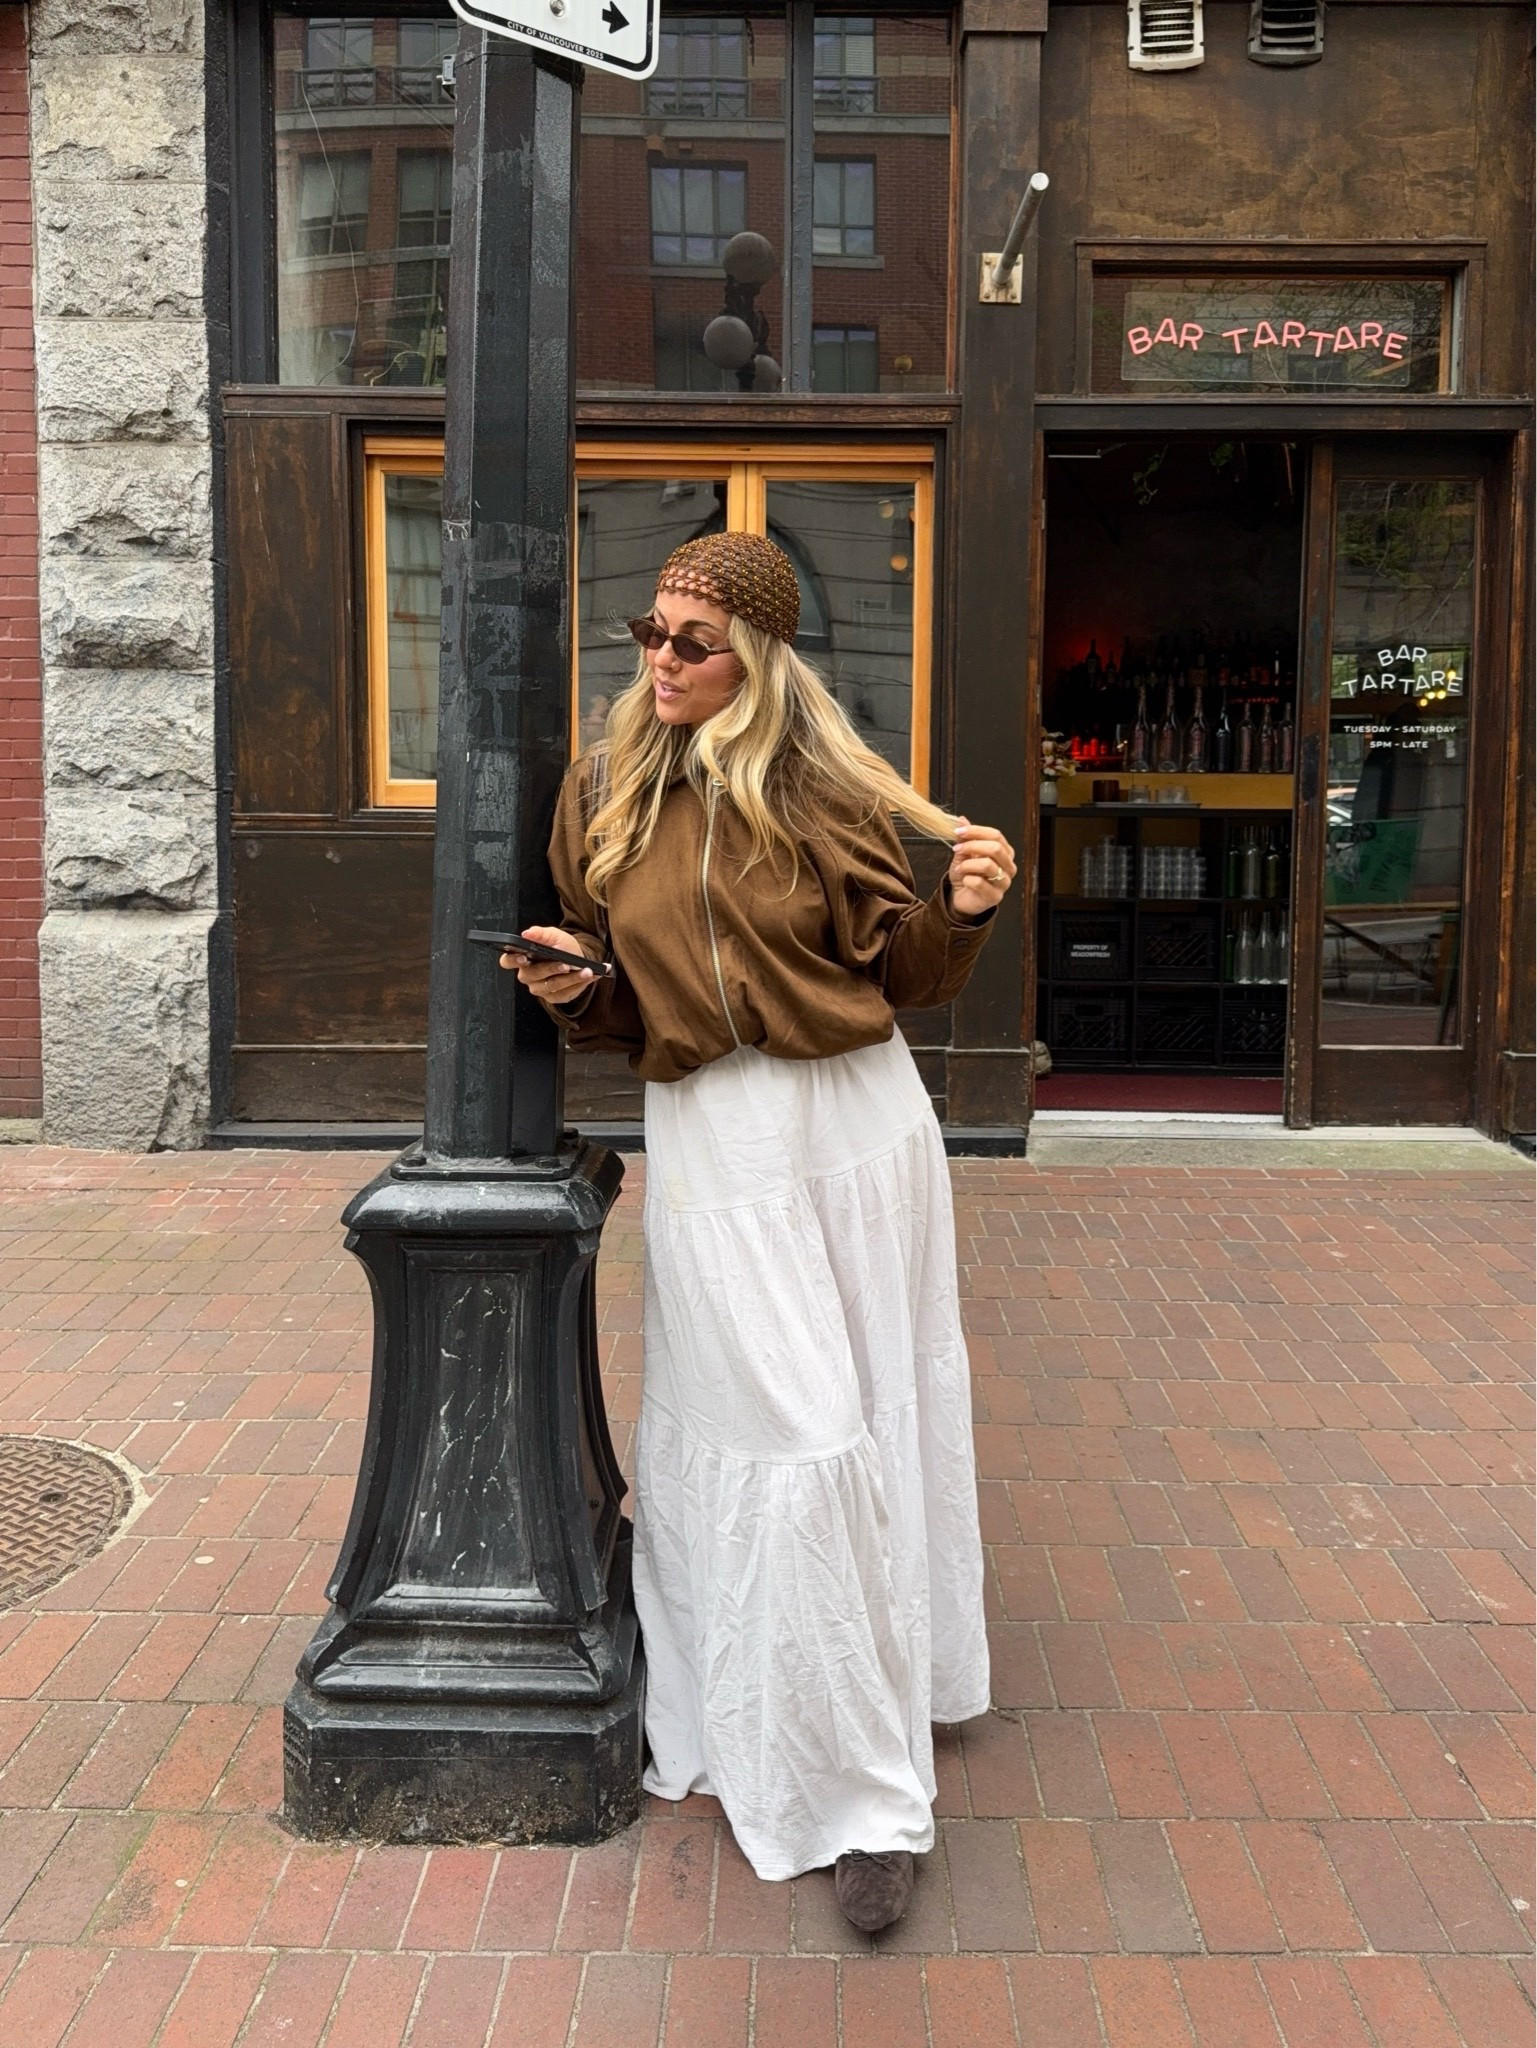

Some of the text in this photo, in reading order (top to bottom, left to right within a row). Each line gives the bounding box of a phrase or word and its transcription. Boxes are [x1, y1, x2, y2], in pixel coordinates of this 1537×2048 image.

[507, 21, 604, 60] CITY OF VANCOUVER 2025
[1127, 318, 1408, 360] BAR TARTARE
[1377, 644, 1427, 667] BAR
[1340, 670, 1463, 696] TARTARE
[1343, 725, 1392, 733] TUESDAY
[1402, 725, 1456, 733] SATURDAY
[1369, 741, 1392, 749] 5PM
[1402, 741, 1429, 749] LATE
